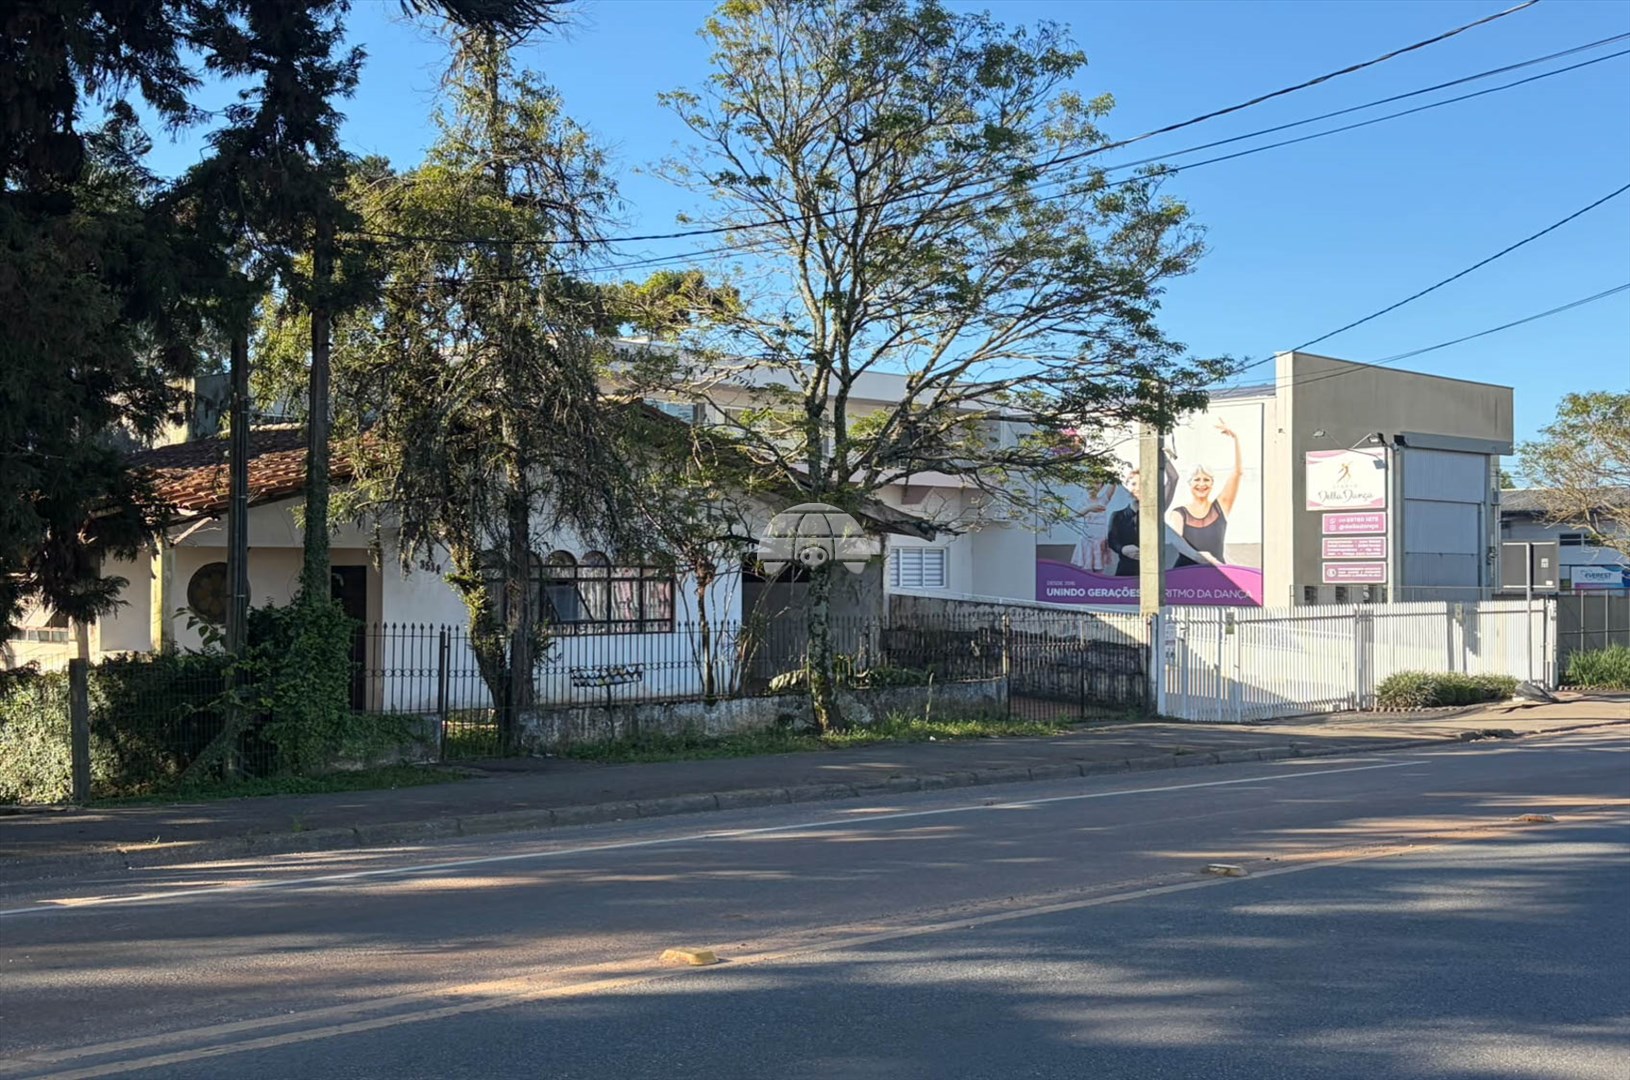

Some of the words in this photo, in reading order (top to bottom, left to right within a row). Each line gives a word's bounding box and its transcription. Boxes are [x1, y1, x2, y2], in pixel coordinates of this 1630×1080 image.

[1046, 588, 1085, 596] UNINDO
[1087, 586, 1141, 598] GERAÇÕES
[1196, 589, 1212, 598] DA
[1213, 589, 1253, 600] DANÇA
